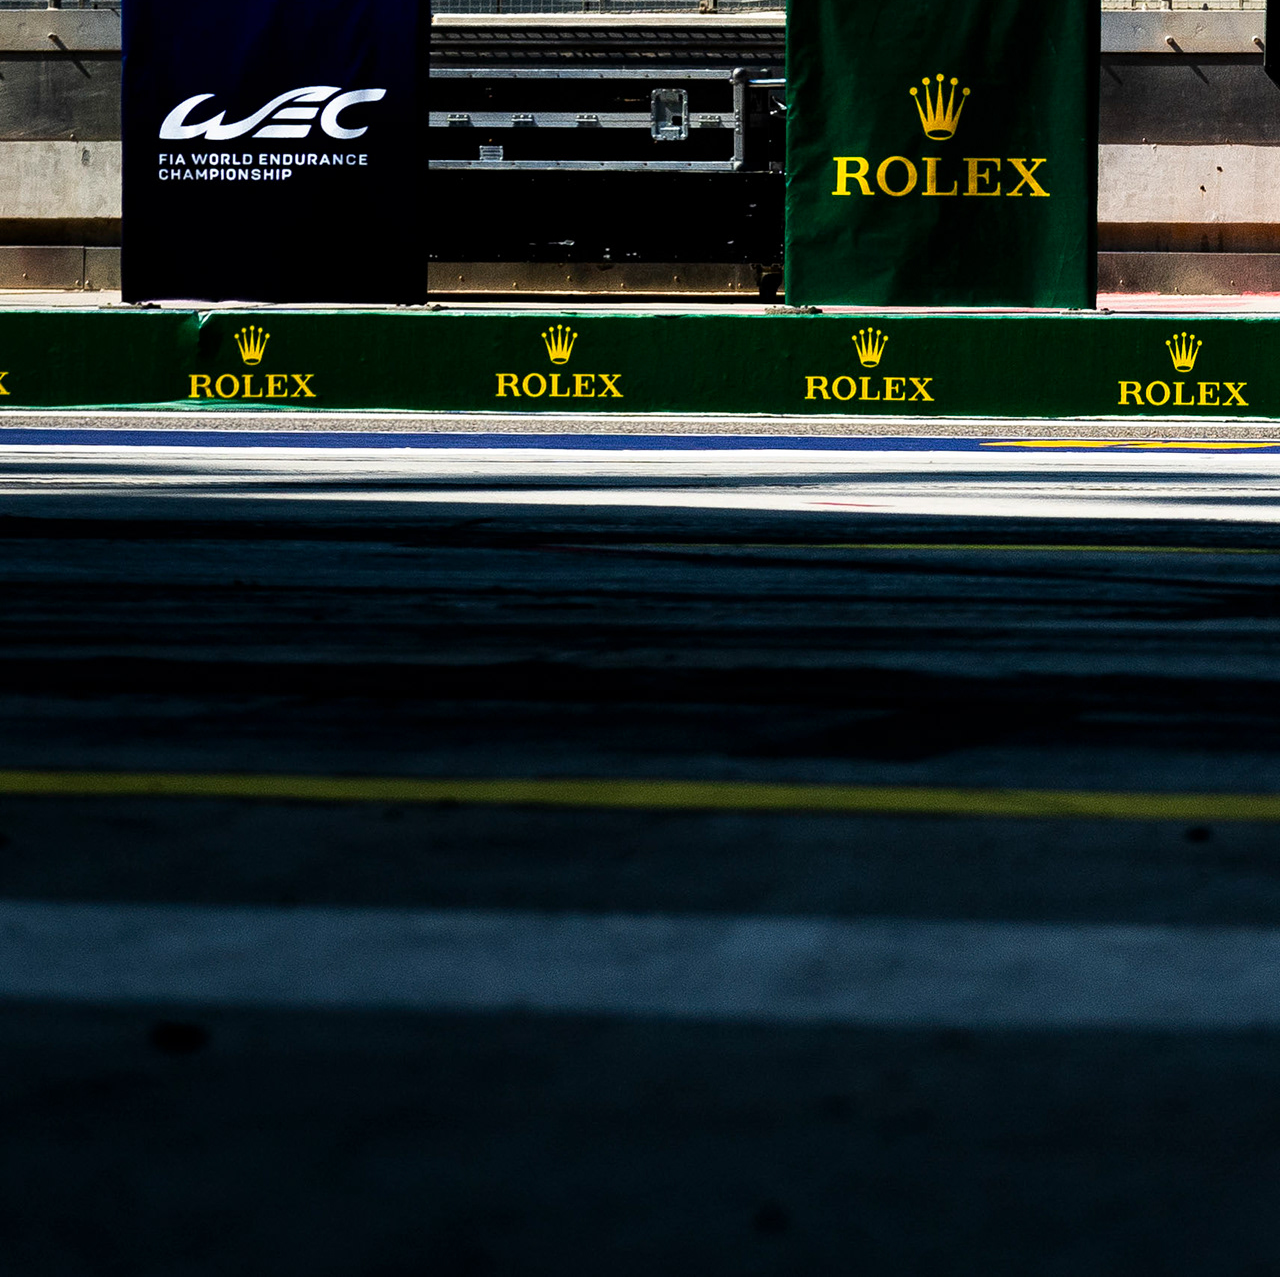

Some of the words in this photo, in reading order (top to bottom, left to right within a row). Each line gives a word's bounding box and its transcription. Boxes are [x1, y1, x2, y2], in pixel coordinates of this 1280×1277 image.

[158, 85, 388, 141] WEC
[158, 153, 187, 167] FIA
[191, 153, 254, 167] WORLD
[258, 153, 369, 167] ENDURANCE
[158, 168, 293, 182] CHAMPIONSHIP
[830, 156, 1051, 198] ROLEX
[188, 373, 317, 399] ROLEX
[494, 372, 624, 399] ROLEX
[803, 375, 936, 402] ROLEX
[1117, 380, 1250, 407] ROLEX
